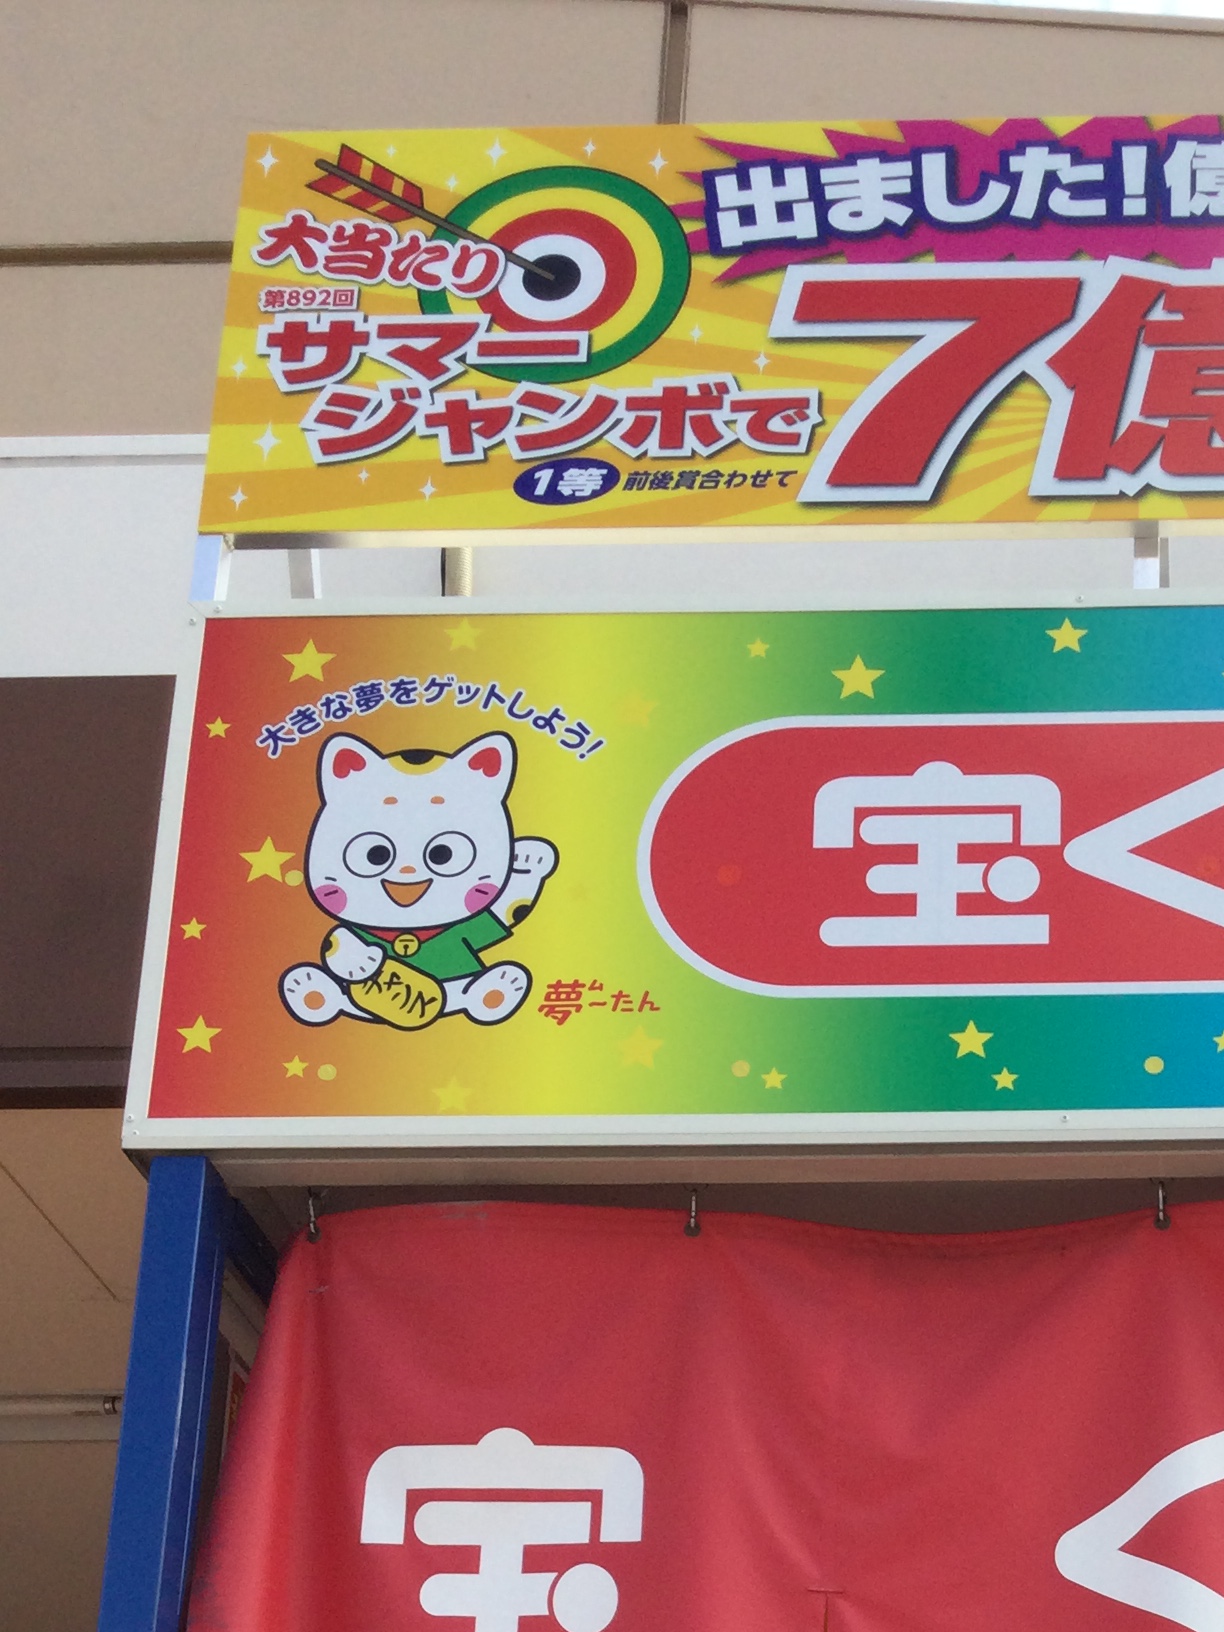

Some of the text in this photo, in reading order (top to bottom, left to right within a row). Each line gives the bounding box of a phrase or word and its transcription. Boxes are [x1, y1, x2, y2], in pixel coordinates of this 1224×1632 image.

[254, 210, 506, 298] 大当たり
[258, 286, 357, 312] 第892回
[258, 311, 592, 392] サマー
[301, 373, 824, 463] ジャンボで
[530, 466, 798, 499] 1等 前後賞合わせて
